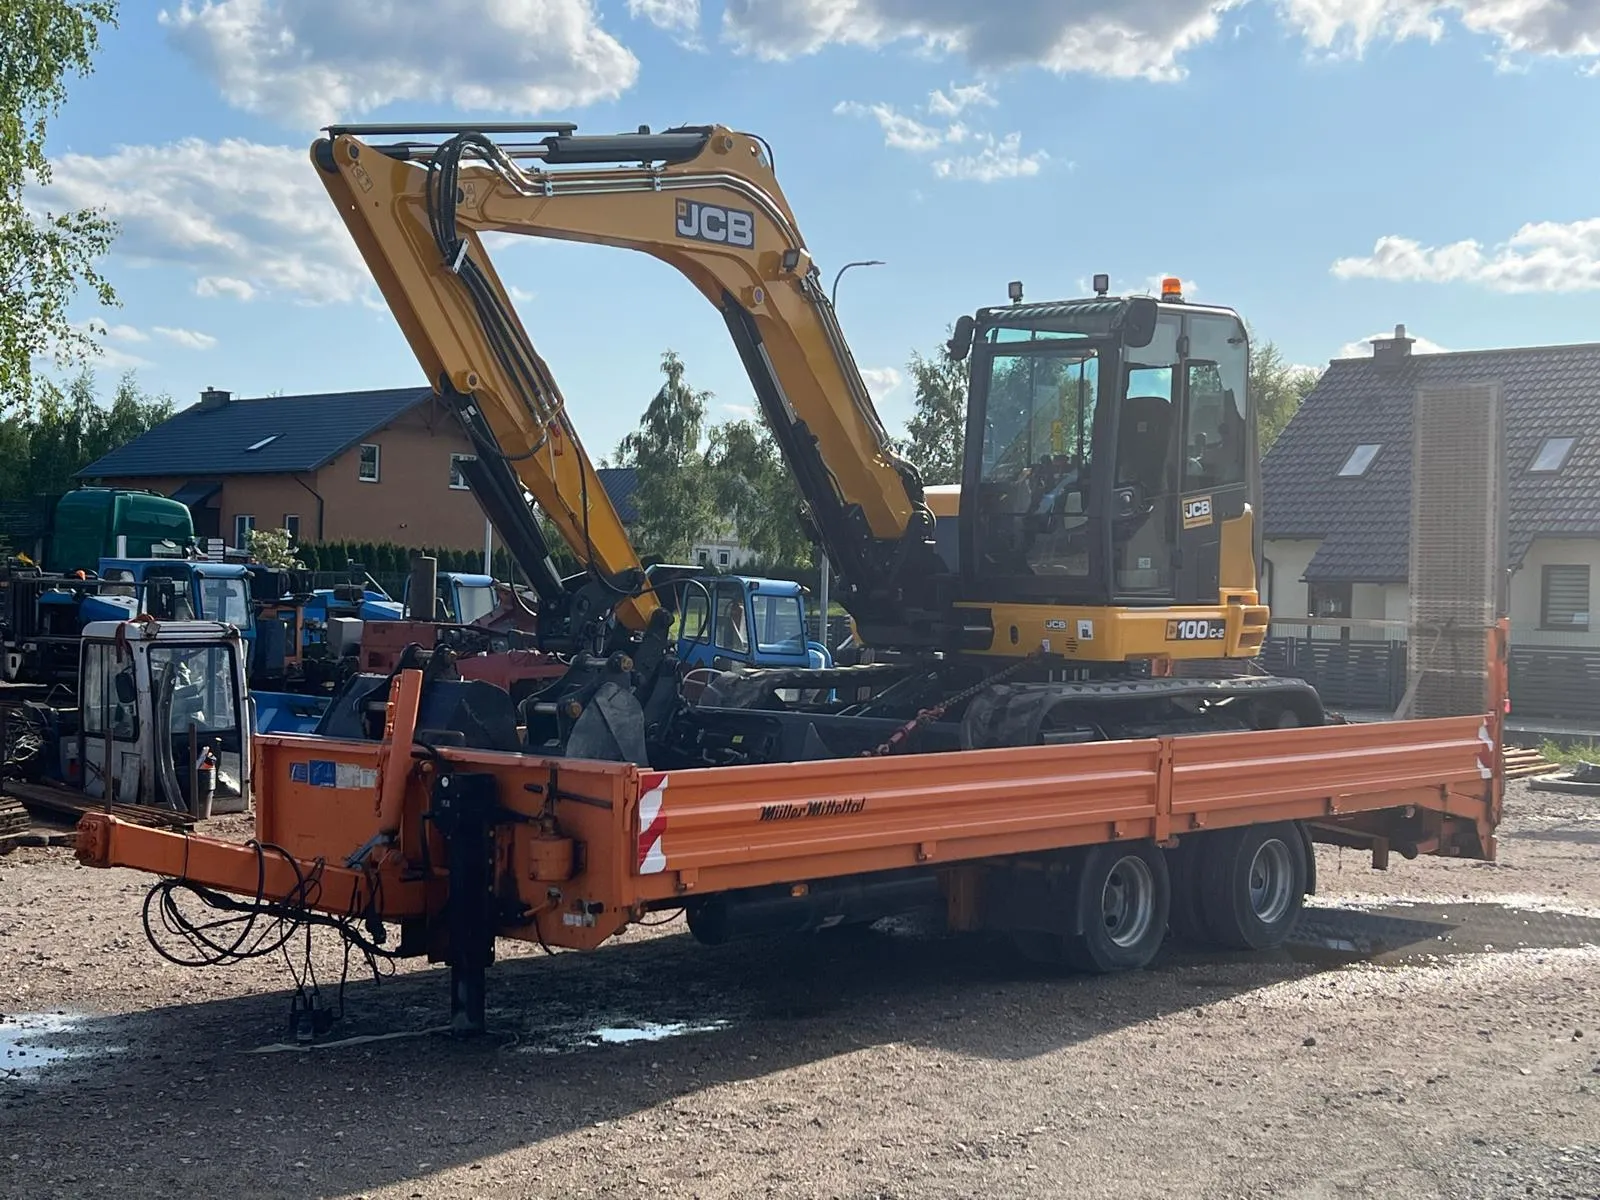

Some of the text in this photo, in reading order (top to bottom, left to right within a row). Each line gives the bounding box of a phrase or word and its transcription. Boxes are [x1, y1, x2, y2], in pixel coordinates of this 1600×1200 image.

[678, 204, 753, 246] JCB
[1185, 501, 1210, 518] JCB
[1046, 620, 1066, 629] JCB
[1178, 620, 1208, 639] 100
[759, 798, 866, 821] Müller Mitteltal
